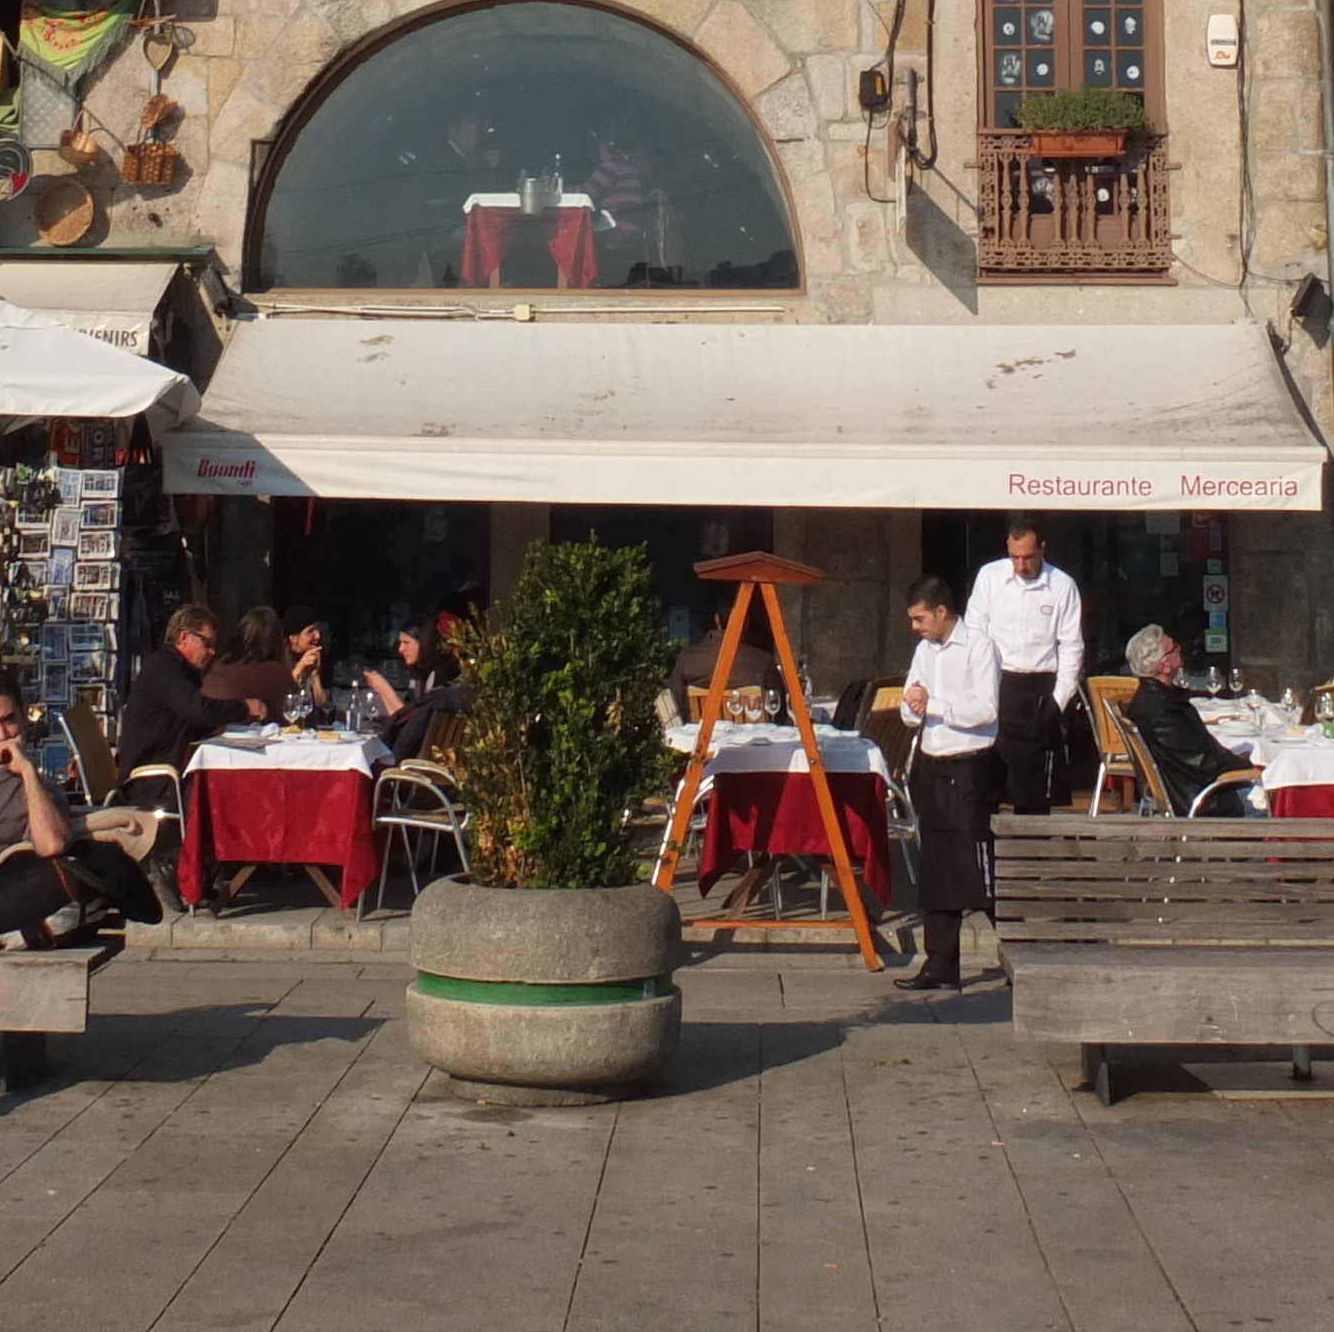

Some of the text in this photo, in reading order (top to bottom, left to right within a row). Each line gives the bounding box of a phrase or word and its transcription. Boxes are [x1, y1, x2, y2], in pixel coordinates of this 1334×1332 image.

[196, 458, 256, 478] Buondi
[1008, 473, 1299, 497] Restaurante Mercearia
